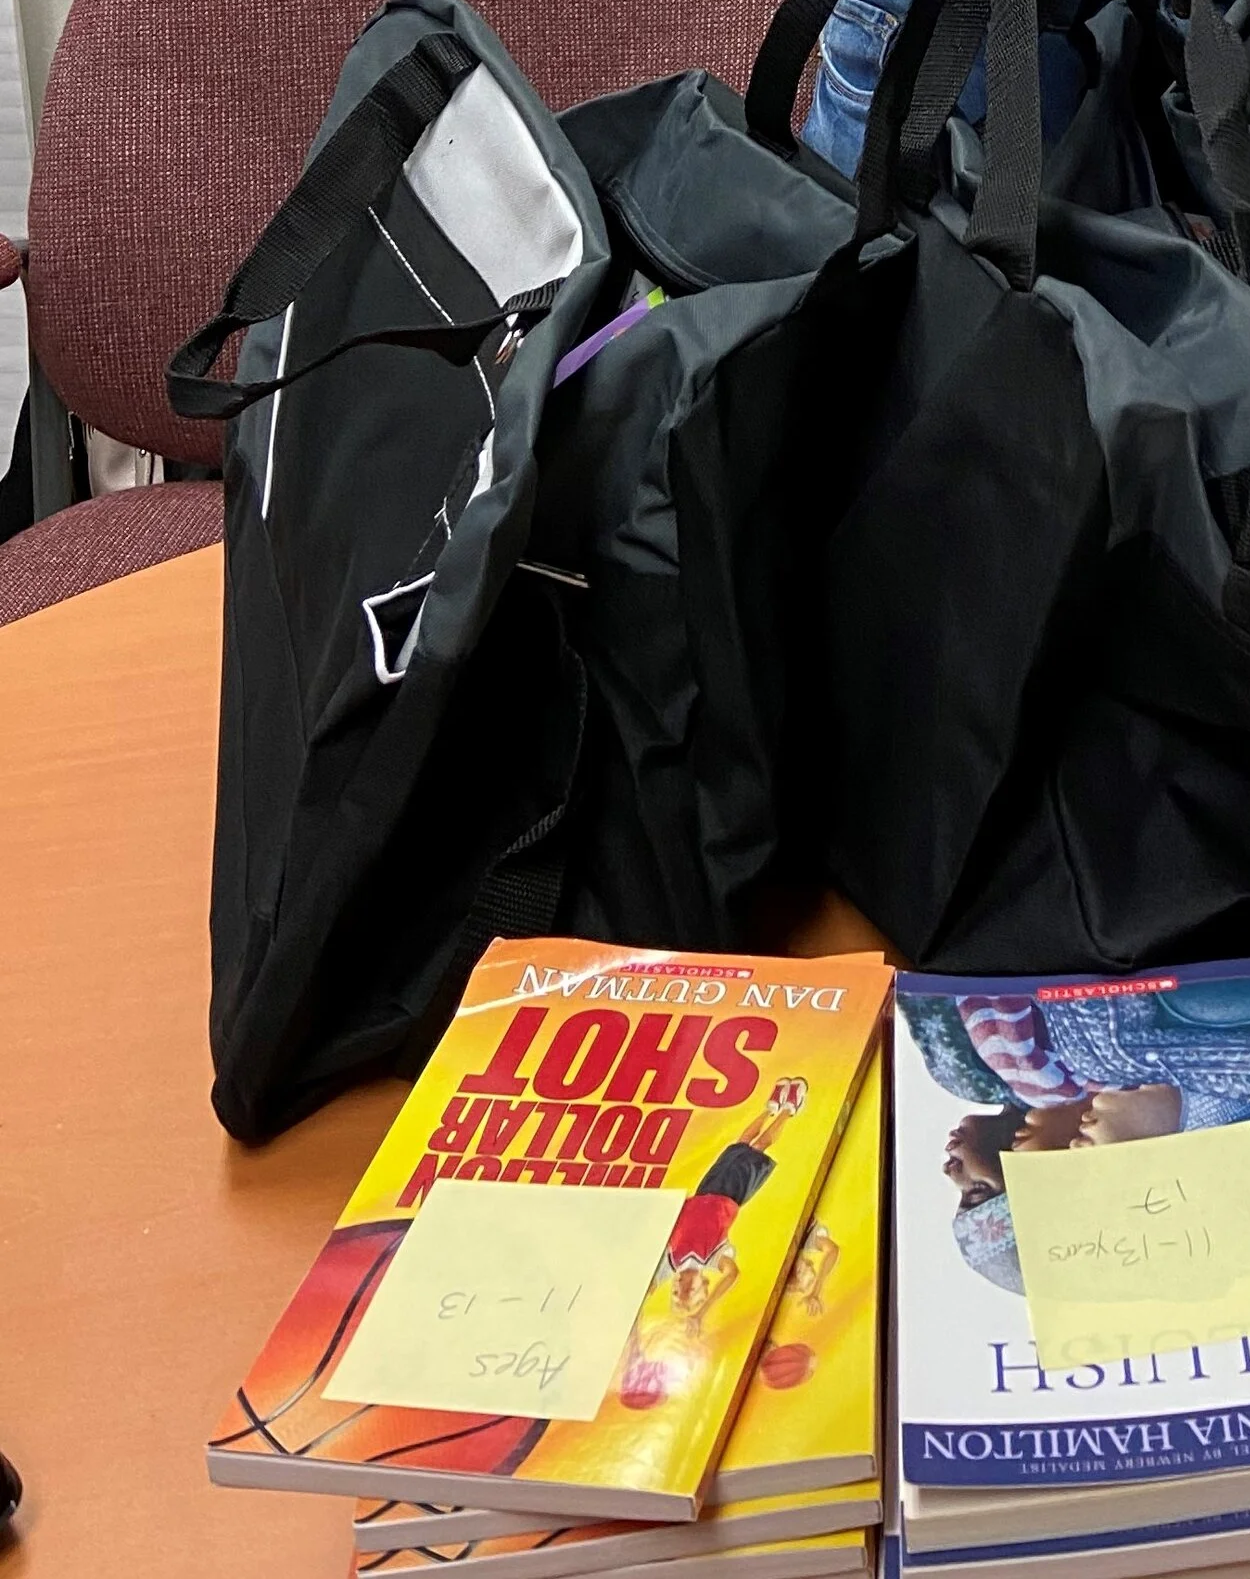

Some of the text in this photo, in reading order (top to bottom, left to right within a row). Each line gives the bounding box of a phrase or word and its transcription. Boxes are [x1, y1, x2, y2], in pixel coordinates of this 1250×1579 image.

[622, 963, 736, 979] SCHOLASTIC
[514, 964, 849, 1012] DAN GUTMAN
[1041, 981, 1157, 1000] SCHOLASTIC
[456, 1006, 779, 1108] SHOT
[427, 1096, 693, 1165] DOLLAR
[468, 1340, 571, 1390] Ages
[923, 1421, 1172, 1462] HAMILTON
[1202, 1446, 1224, 1461] BY
[1019, 1459, 1108, 1475] MEDALIST
[1114, 1452, 1196, 1471] NEWBERY
